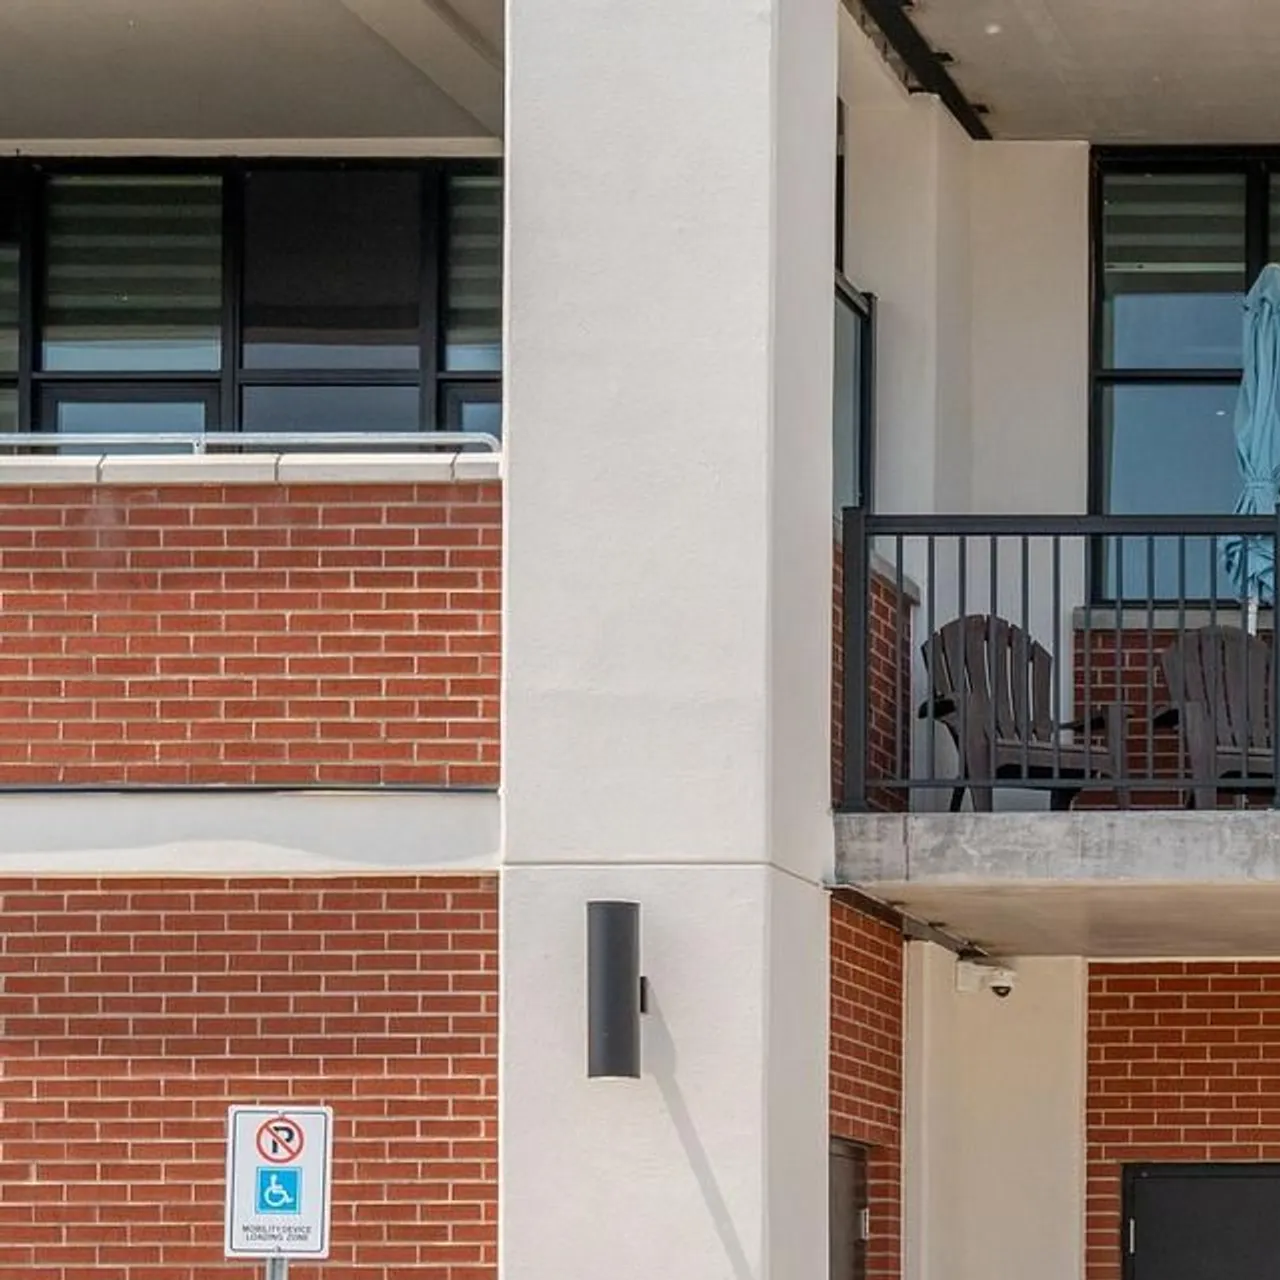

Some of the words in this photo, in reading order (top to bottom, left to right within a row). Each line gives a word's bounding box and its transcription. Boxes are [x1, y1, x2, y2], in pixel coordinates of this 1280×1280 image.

[272, 1126, 294, 1153] P
[282, 1225, 312, 1233] DEVICE
[246, 1233, 283, 1241] LOADING
[286, 1233, 308, 1241] ZONE
